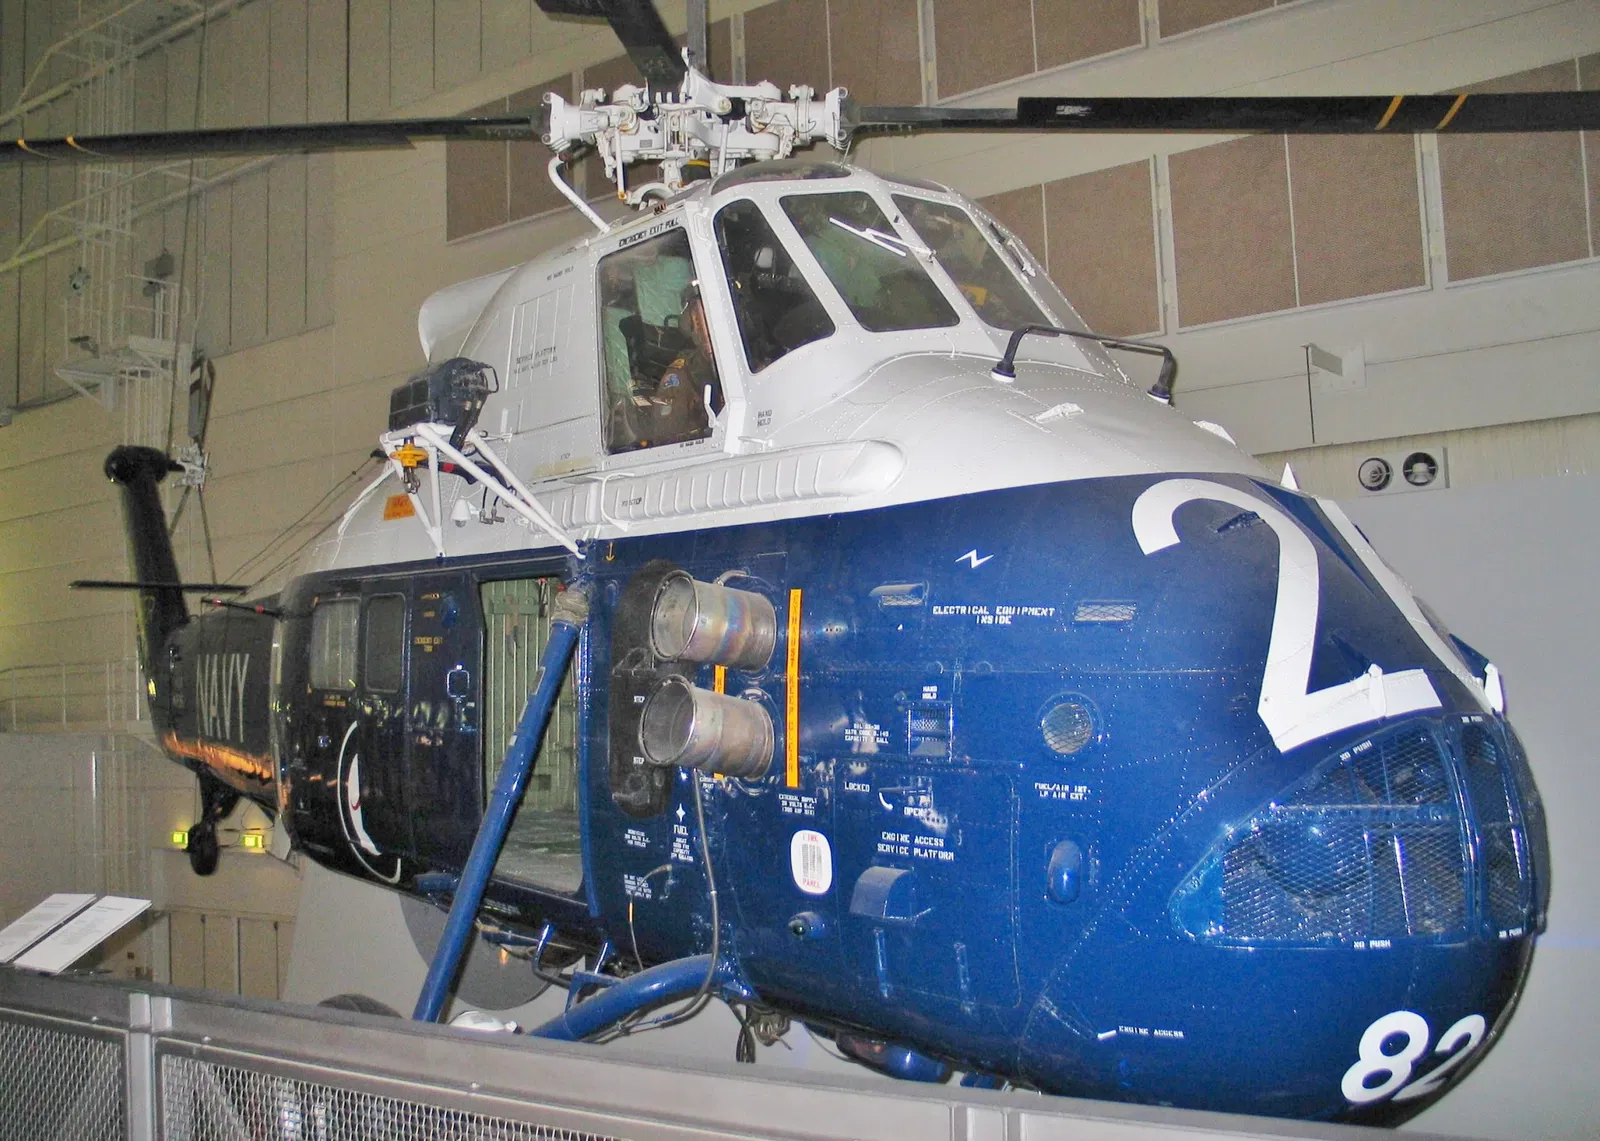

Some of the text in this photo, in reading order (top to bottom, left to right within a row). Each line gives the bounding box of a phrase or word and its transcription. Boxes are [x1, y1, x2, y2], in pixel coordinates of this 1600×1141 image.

[649, 223, 664, 236] EXIT
[665, 217, 679, 230] PULL
[758, 410, 772, 419] HAND
[757, 418, 771, 427] HOLD
[932, 605, 1056, 617] ELECTRICAL EQUIPMENT
[976, 615, 1012, 625] INSIDE
[196, 652, 250, 743] NAVY
[1339, 739, 1373, 761] NO PUSH
[844, 781, 870, 793] LOCKED
[903, 806, 924, 816] OPEN
[673, 824, 689, 836] FUEL
[881, 831, 945, 847] ENGINE ACCESS
[877, 843, 955, 860] SERVICE PLATFORM
[803, 879, 821, 889] PANEL
[1353, 940, 1391, 949] NO PUSH
[1118, 1025, 1184, 1038] ENGINE ACCESS
[1341, 1010, 1487, 1104] 82
